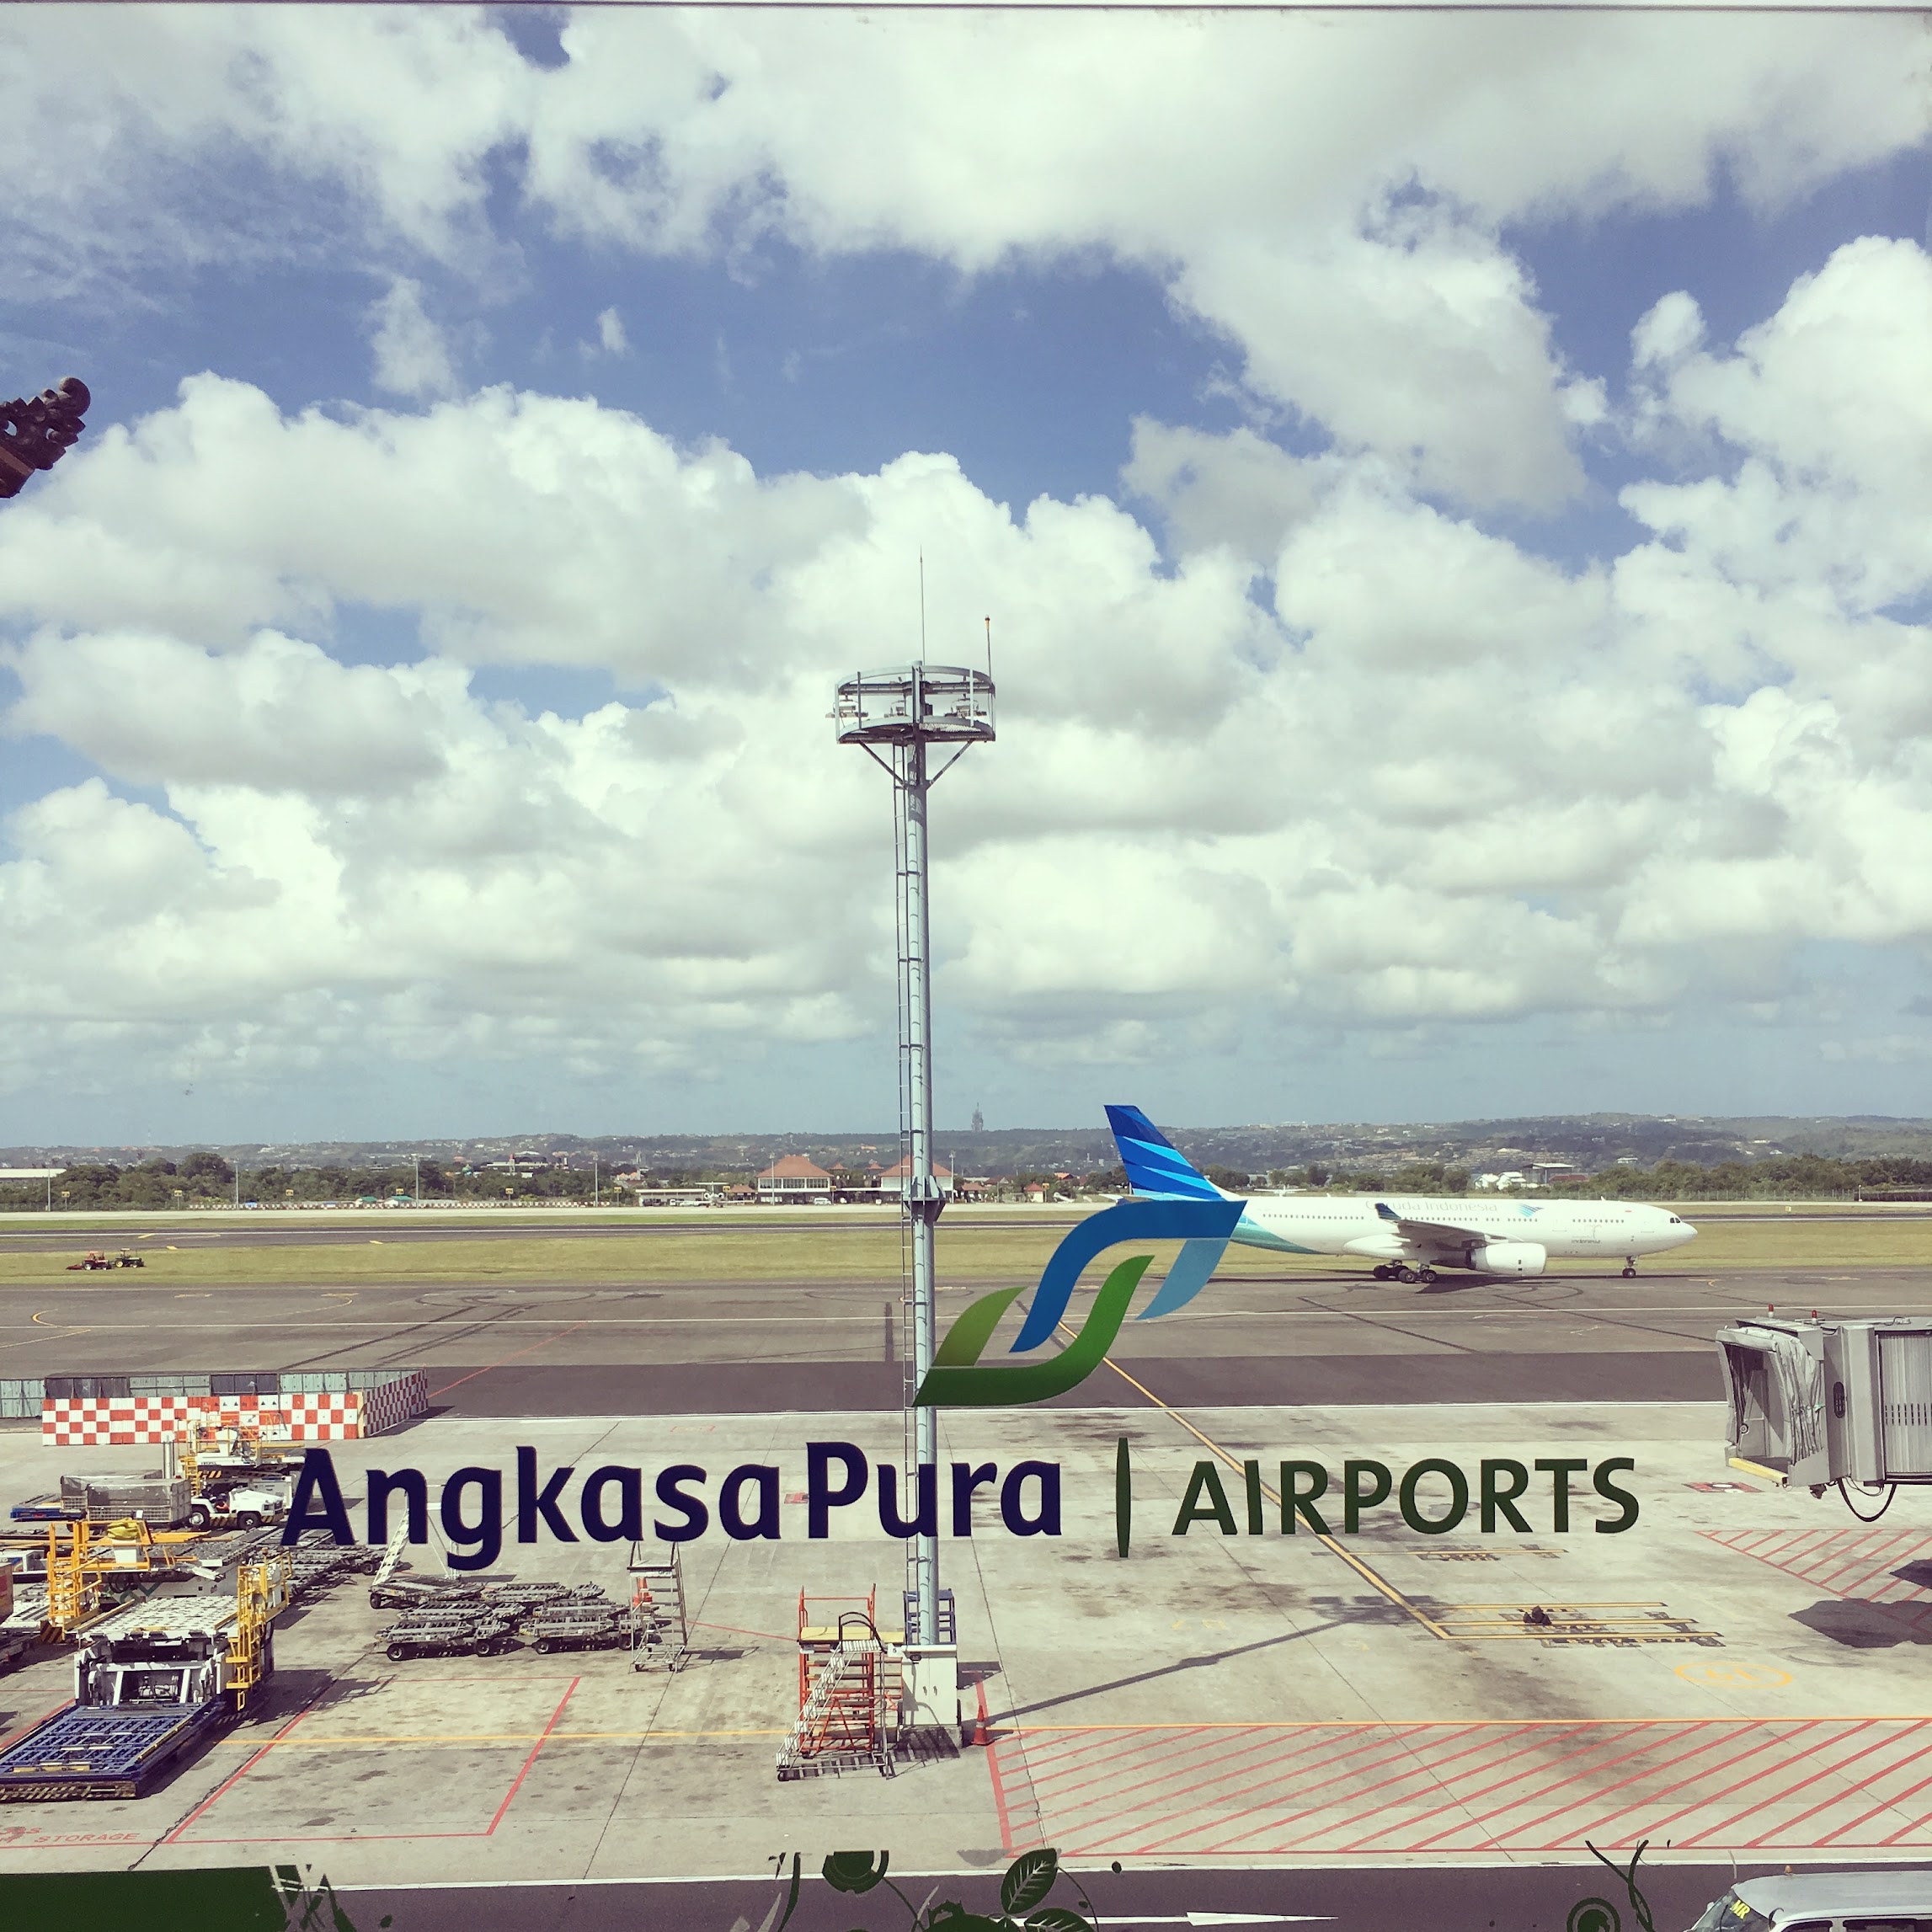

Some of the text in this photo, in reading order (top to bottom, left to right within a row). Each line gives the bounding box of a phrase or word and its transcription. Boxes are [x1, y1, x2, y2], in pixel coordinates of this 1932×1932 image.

[1365, 1199, 1497, 1212] Guda Indonesia
[1171, 1458, 1639, 1534] AIRPORTS
[35, 1833, 141, 1843] STORAGE
[1729, 1899, 1751, 1919] MR
